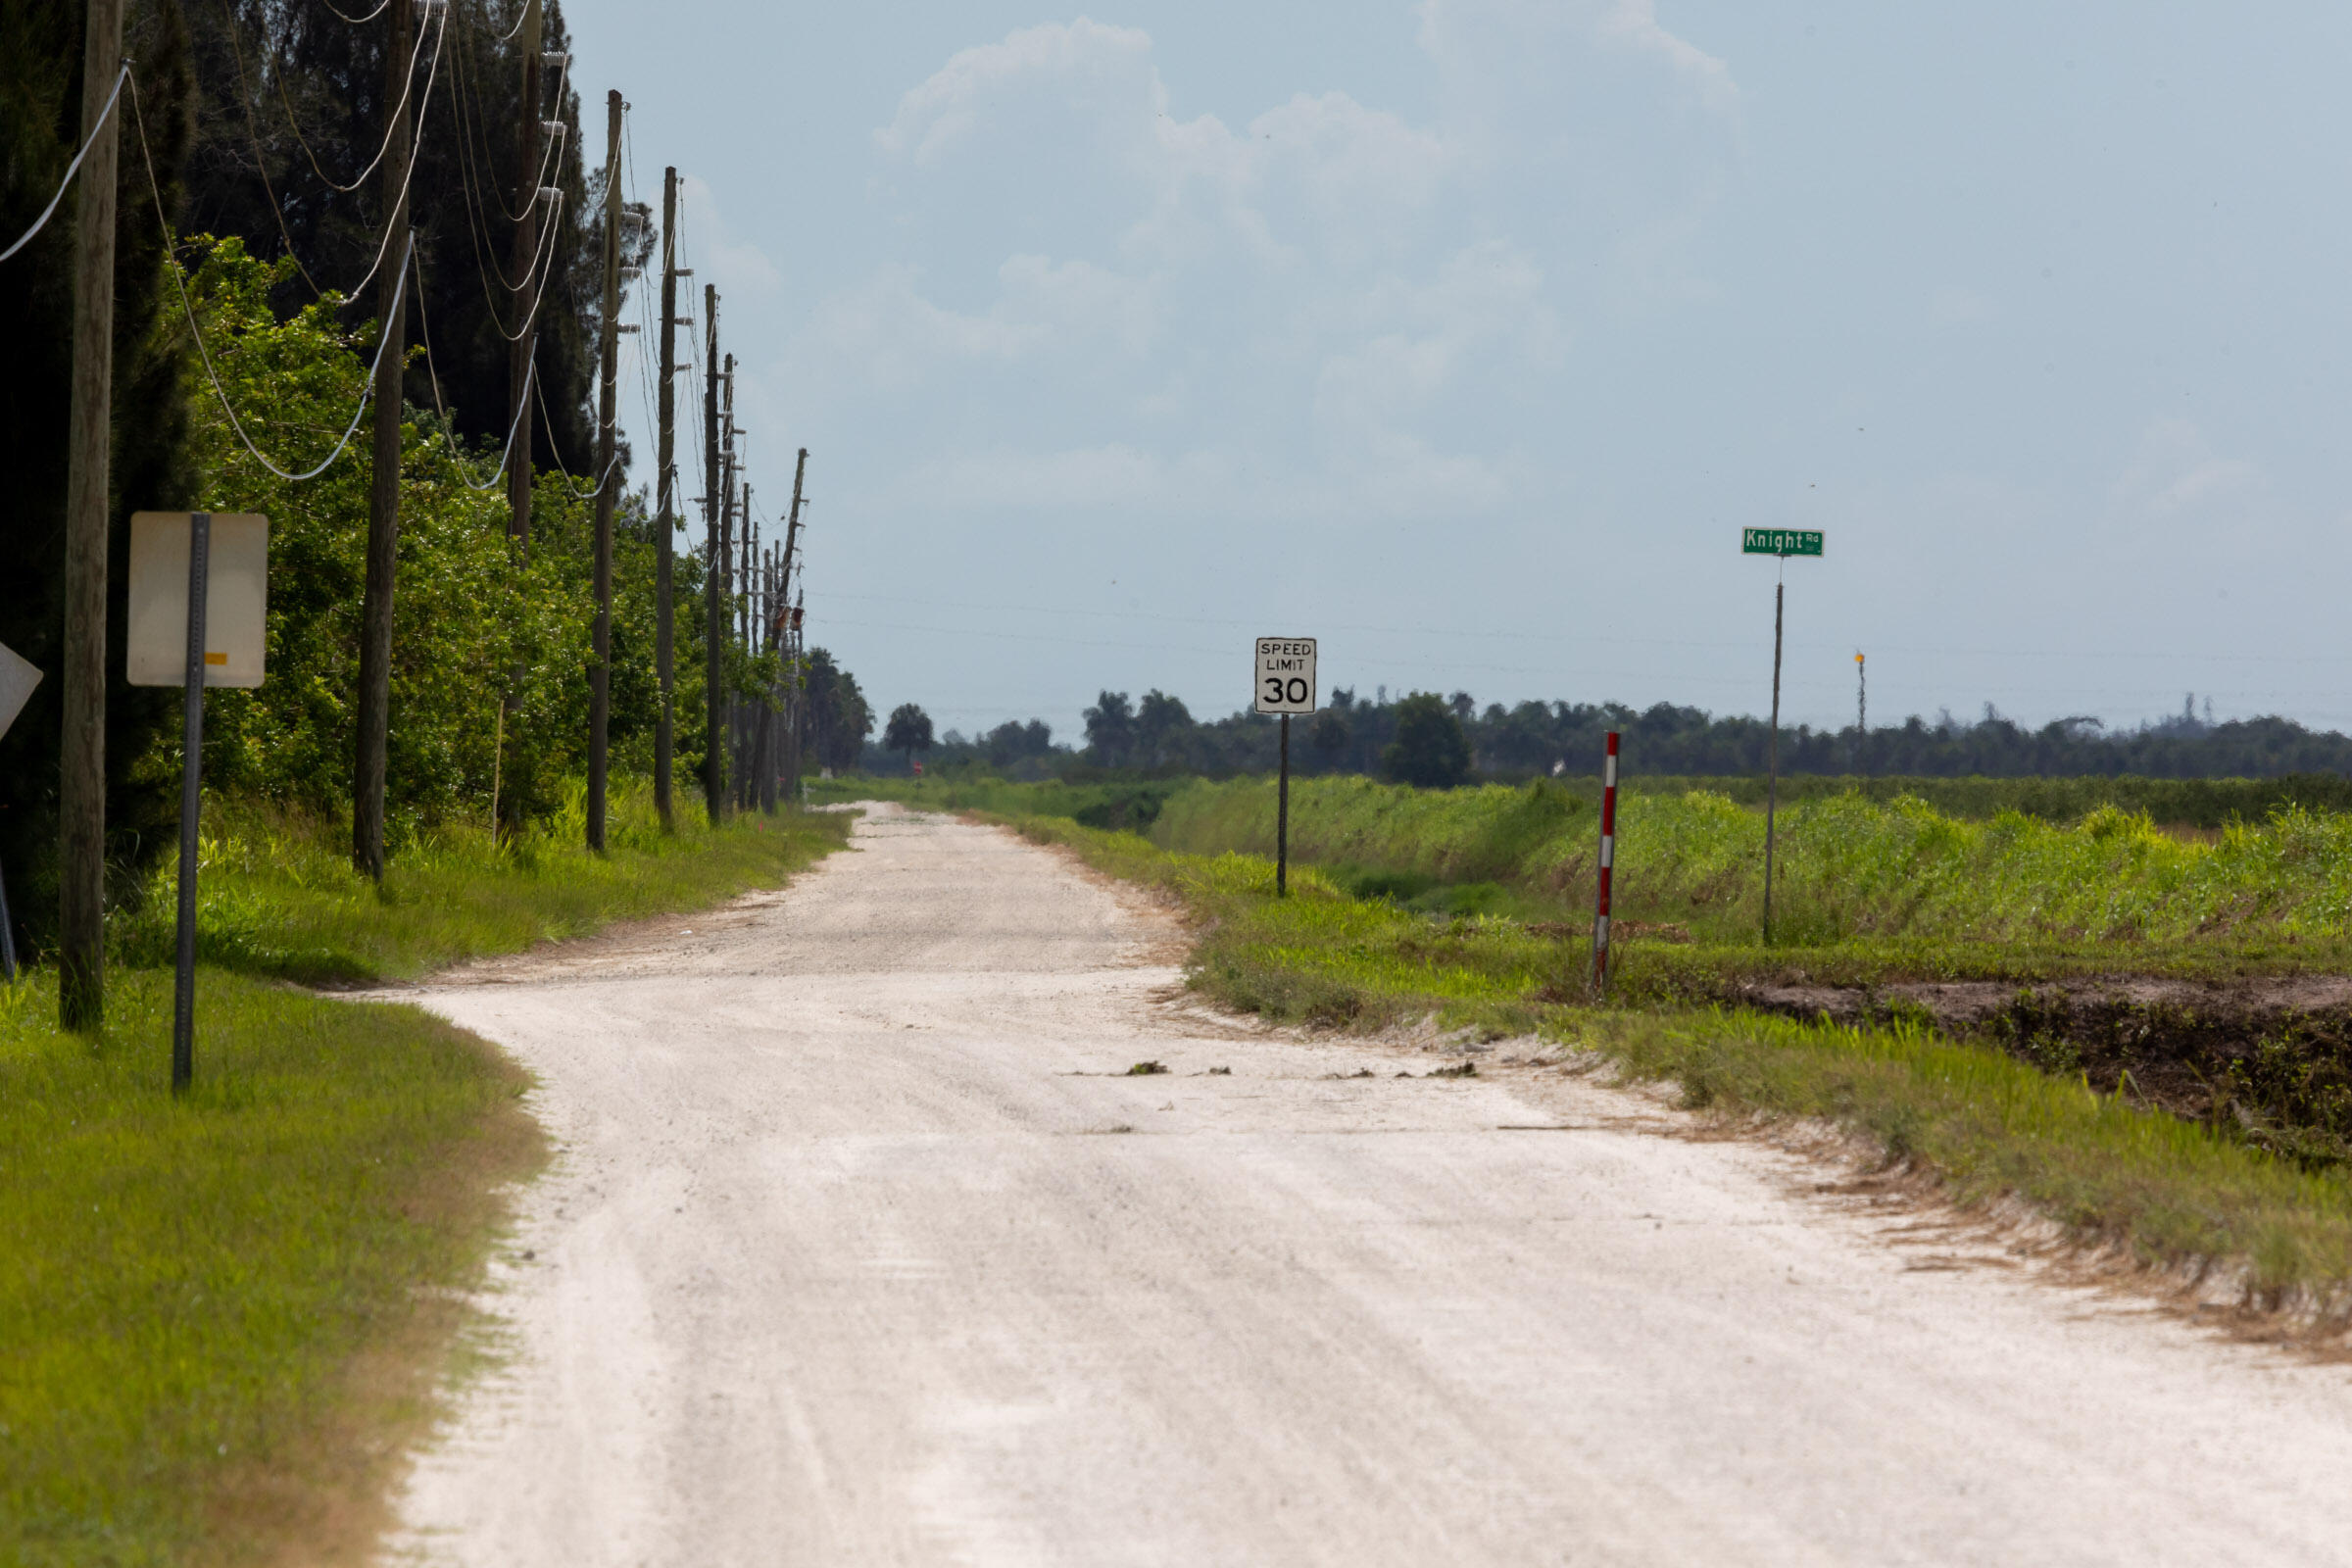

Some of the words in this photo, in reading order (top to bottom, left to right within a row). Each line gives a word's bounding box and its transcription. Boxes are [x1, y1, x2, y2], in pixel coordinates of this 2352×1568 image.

[1746, 530, 1802, 553] Knight
[1806, 533, 1819, 543] Rd
[1261, 643, 1311, 656] SPEED
[1266, 659, 1304, 671] LIMIT
[1263, 677, 1308, 704] 30
